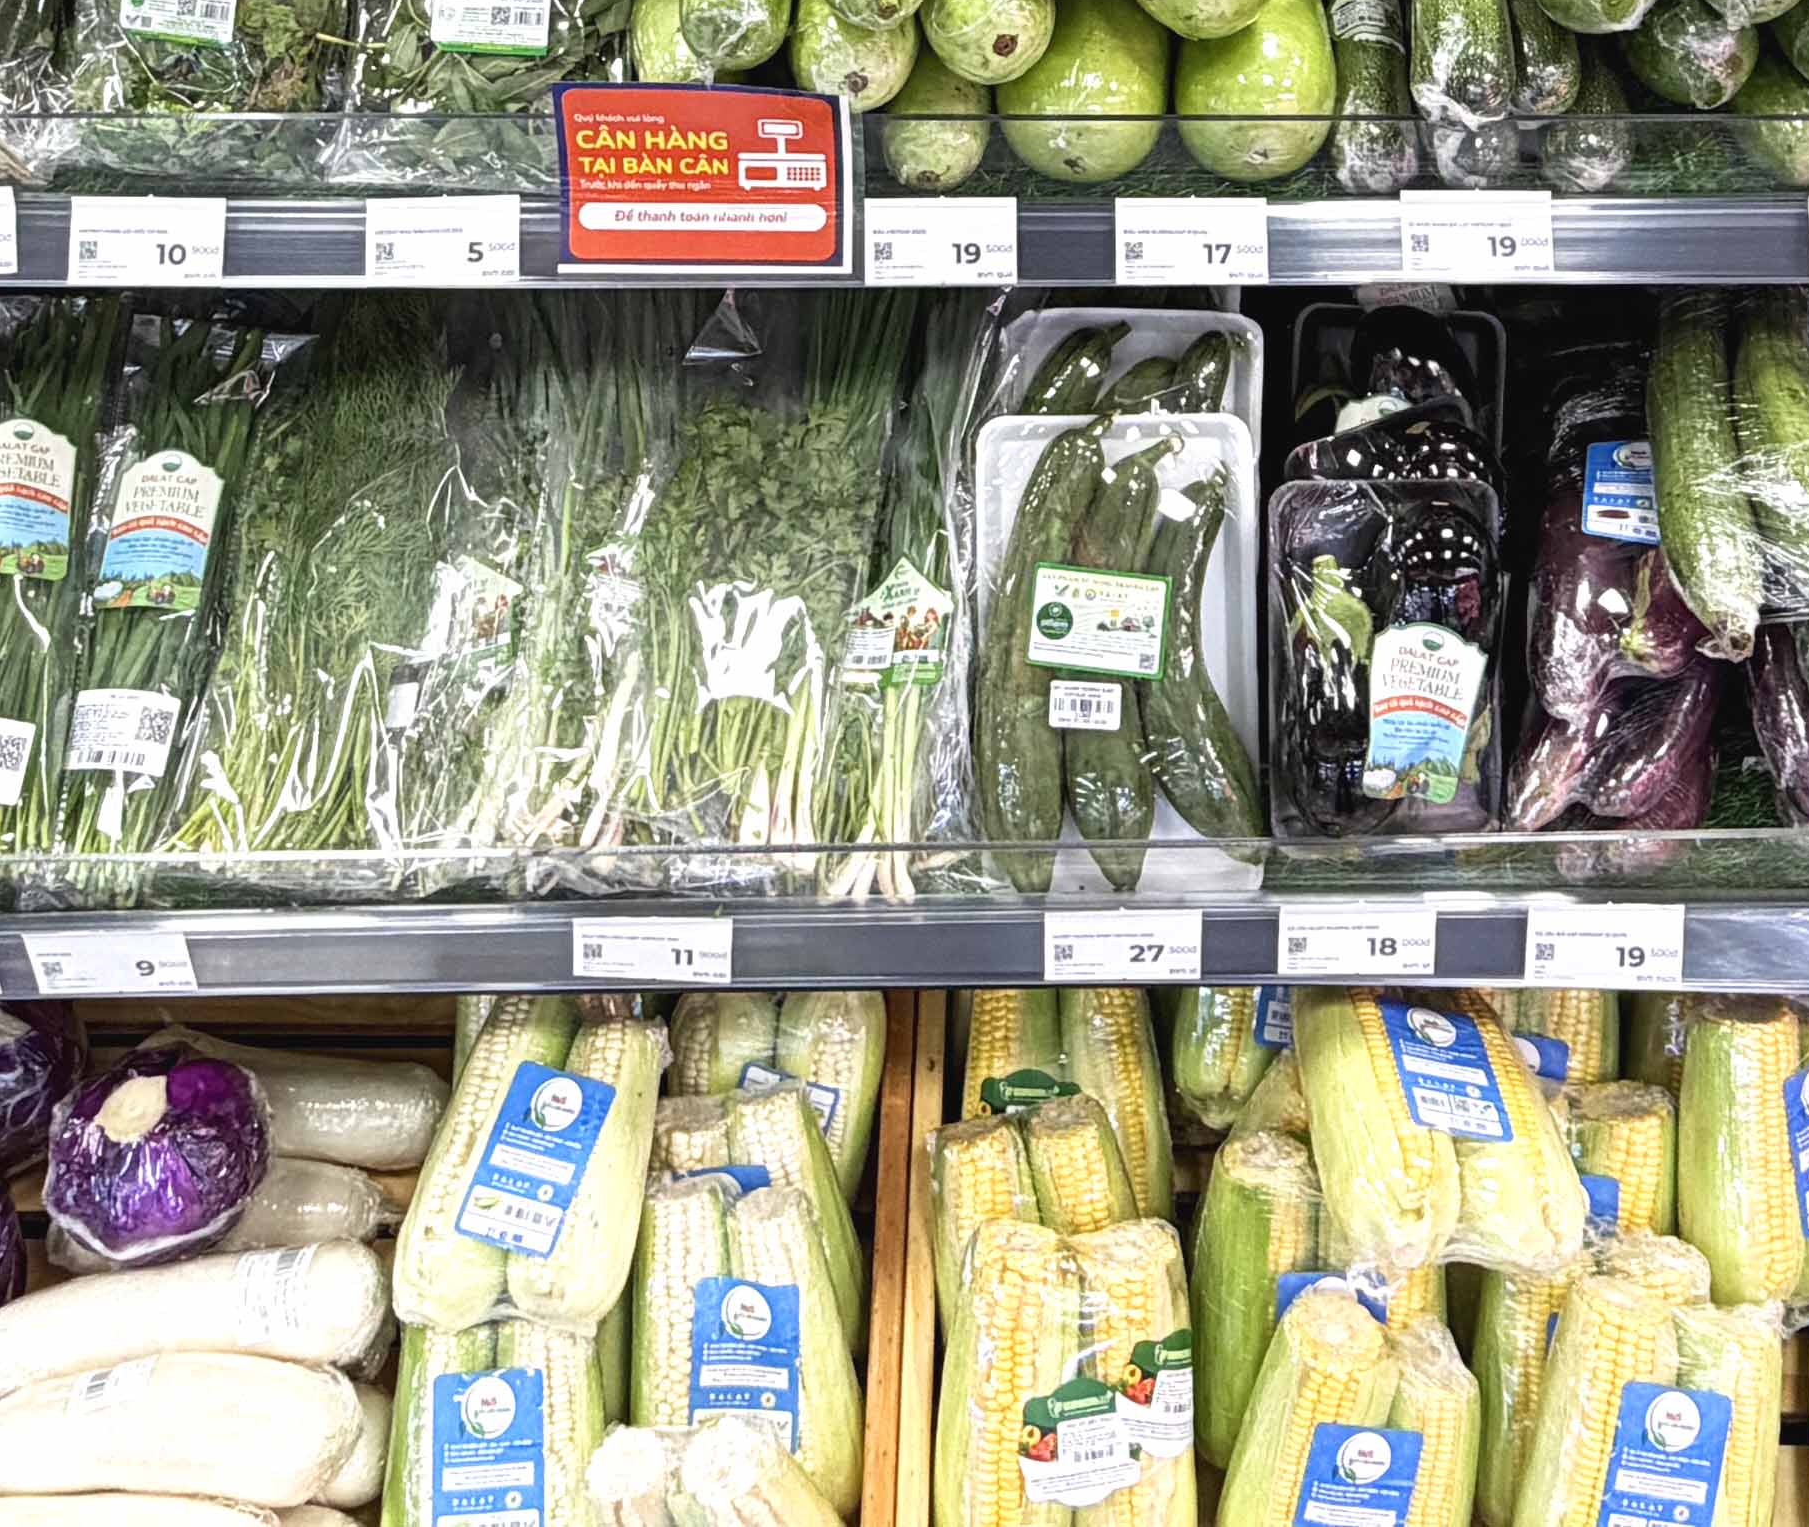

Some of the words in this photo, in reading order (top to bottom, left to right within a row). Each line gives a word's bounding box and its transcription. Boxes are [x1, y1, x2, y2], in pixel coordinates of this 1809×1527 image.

[574, 113, 594, 124] Quý
[596, 113, 625, 123] khách
[643, 114, 665, 124] lòng
[575, 126, 635, 150] CÂN
[645, 125, 728, 151] HÀNG
[578, 156, 616, 177] TẠI
[623, 154, 673, 175] BÀN
[679, 155, 729, 175] CÂN
[615, 209, 634, 222] Để
[637, 211, 677, 223] thanh
[680, 210, 710, 223] toán
[156, 243, 187, 266] 10
[467, 241, 484, 263] 5
[951, 242, 982, 265] 19
[1202, 243, 1232, 265] 17
[1486, 235, 1517, 258] 19
[1397, 645, 1434, 661] DALAT
[1390, 658, 1461, 683] PREMIUM
[1382, 672, 1464, 701] VEGETABLE
[670, 948, 694, 966] 11
[1129, 944, 1165, 963] 27
[1366, 937, 1398, 957] 18
[1615, 946, 1646, 968] 19
[135, 959, 156, 977] 9
